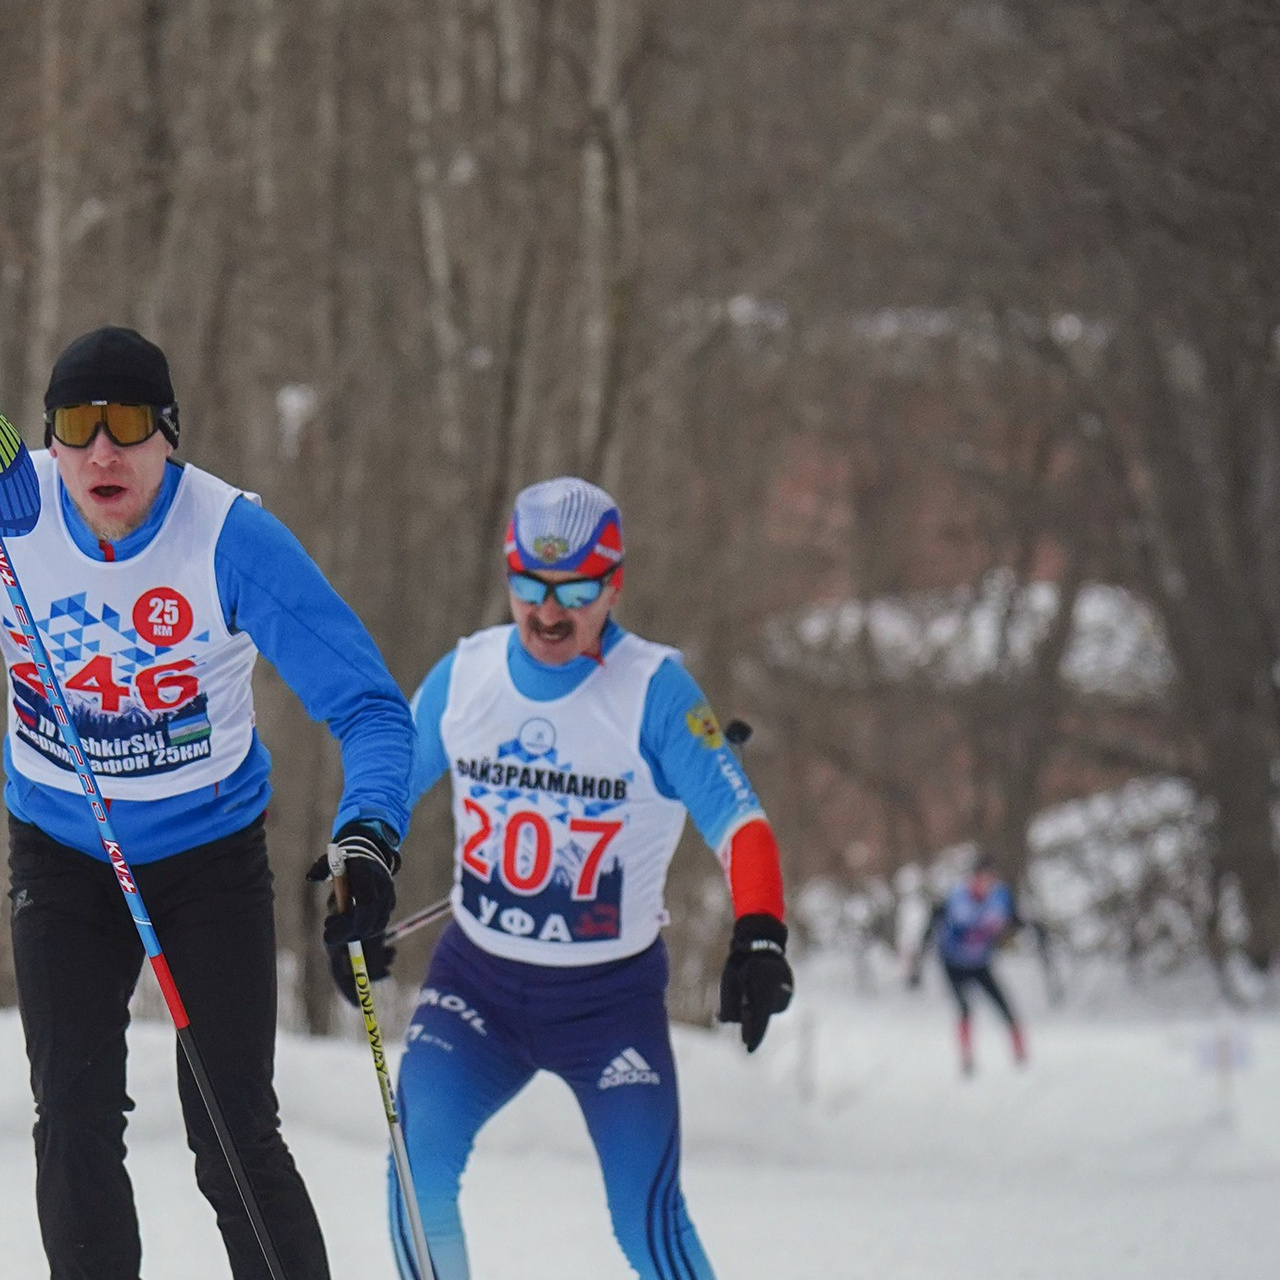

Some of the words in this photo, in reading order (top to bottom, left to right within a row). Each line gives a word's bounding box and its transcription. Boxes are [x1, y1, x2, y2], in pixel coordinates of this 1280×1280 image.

[147, 596, 180, 627] 25
[58, 725, 166, 758] shkirSki
[462, 797, 624, 900] 207
[477, 893, 573, 942] УФА
